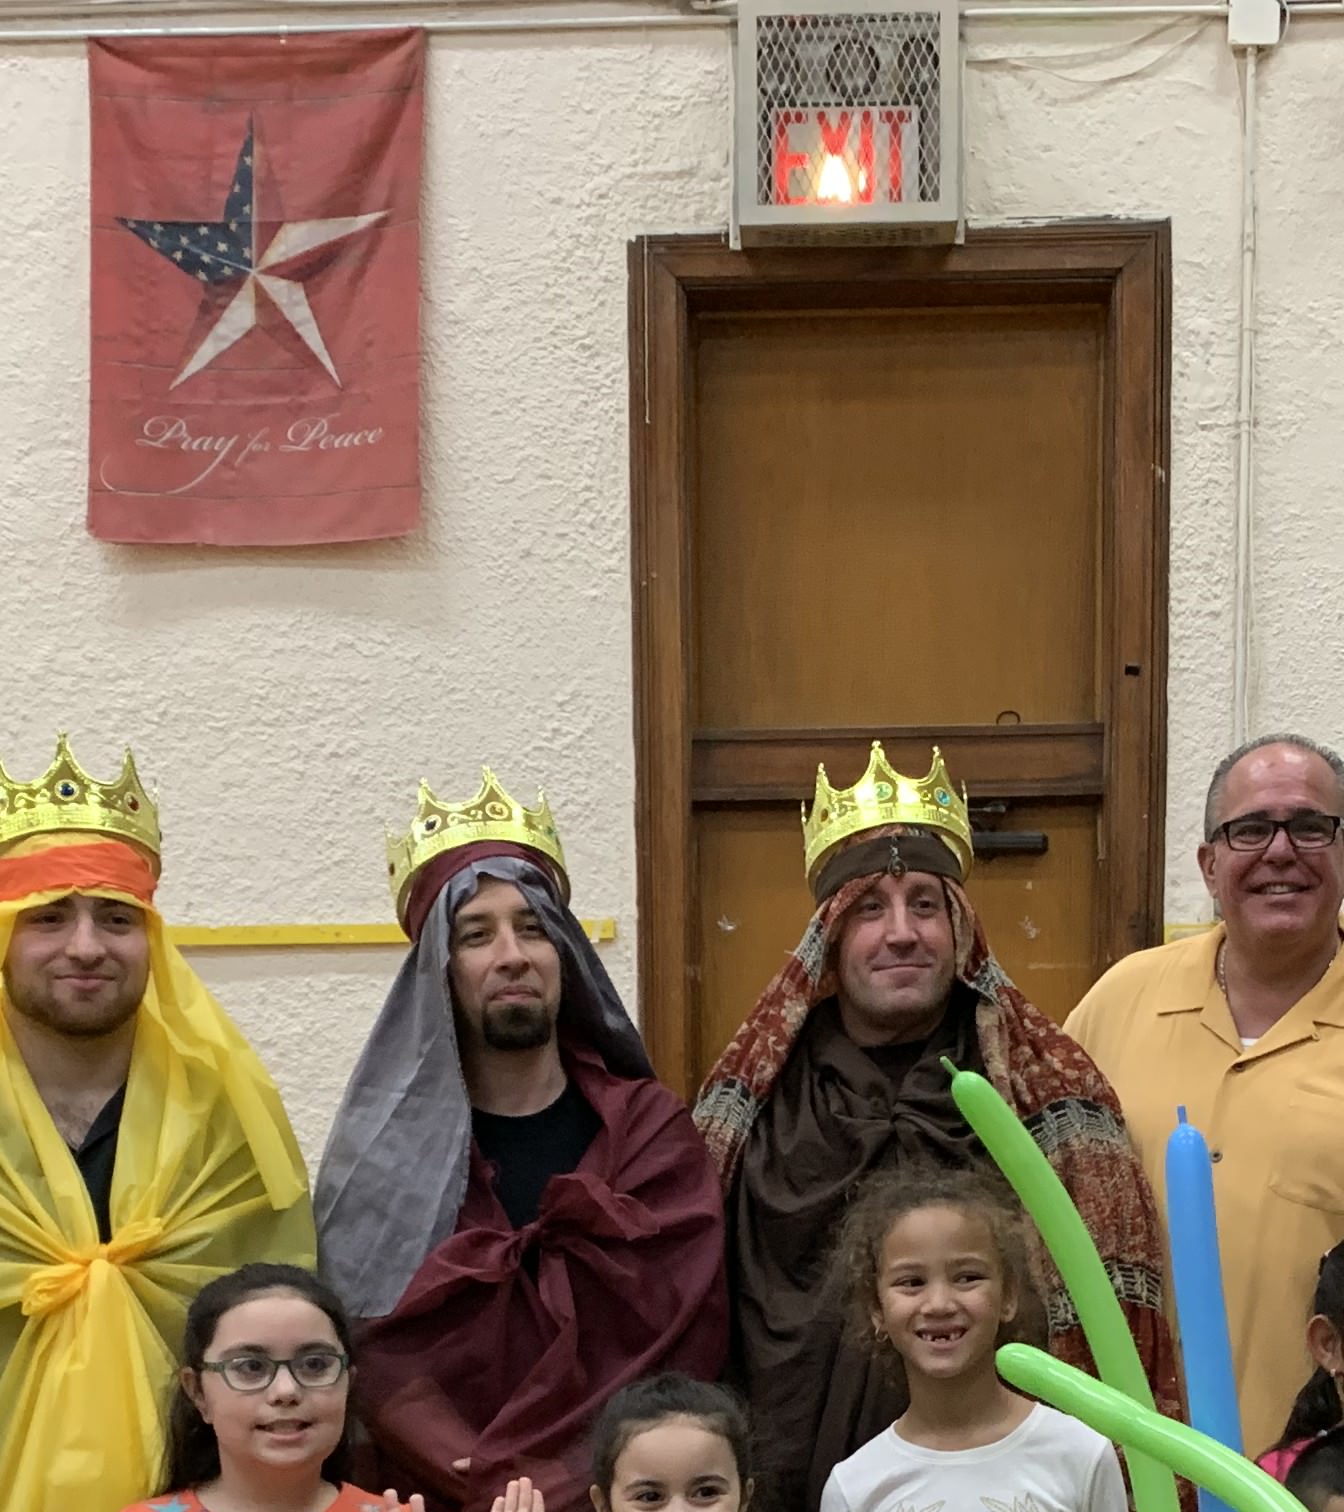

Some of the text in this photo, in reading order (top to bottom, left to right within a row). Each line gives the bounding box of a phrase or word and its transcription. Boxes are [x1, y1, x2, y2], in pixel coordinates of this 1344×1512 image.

[775, 110, 912, 206] EXIT
[234, 427, 270, 466] for
[280, 413, 383, 451] Peace
